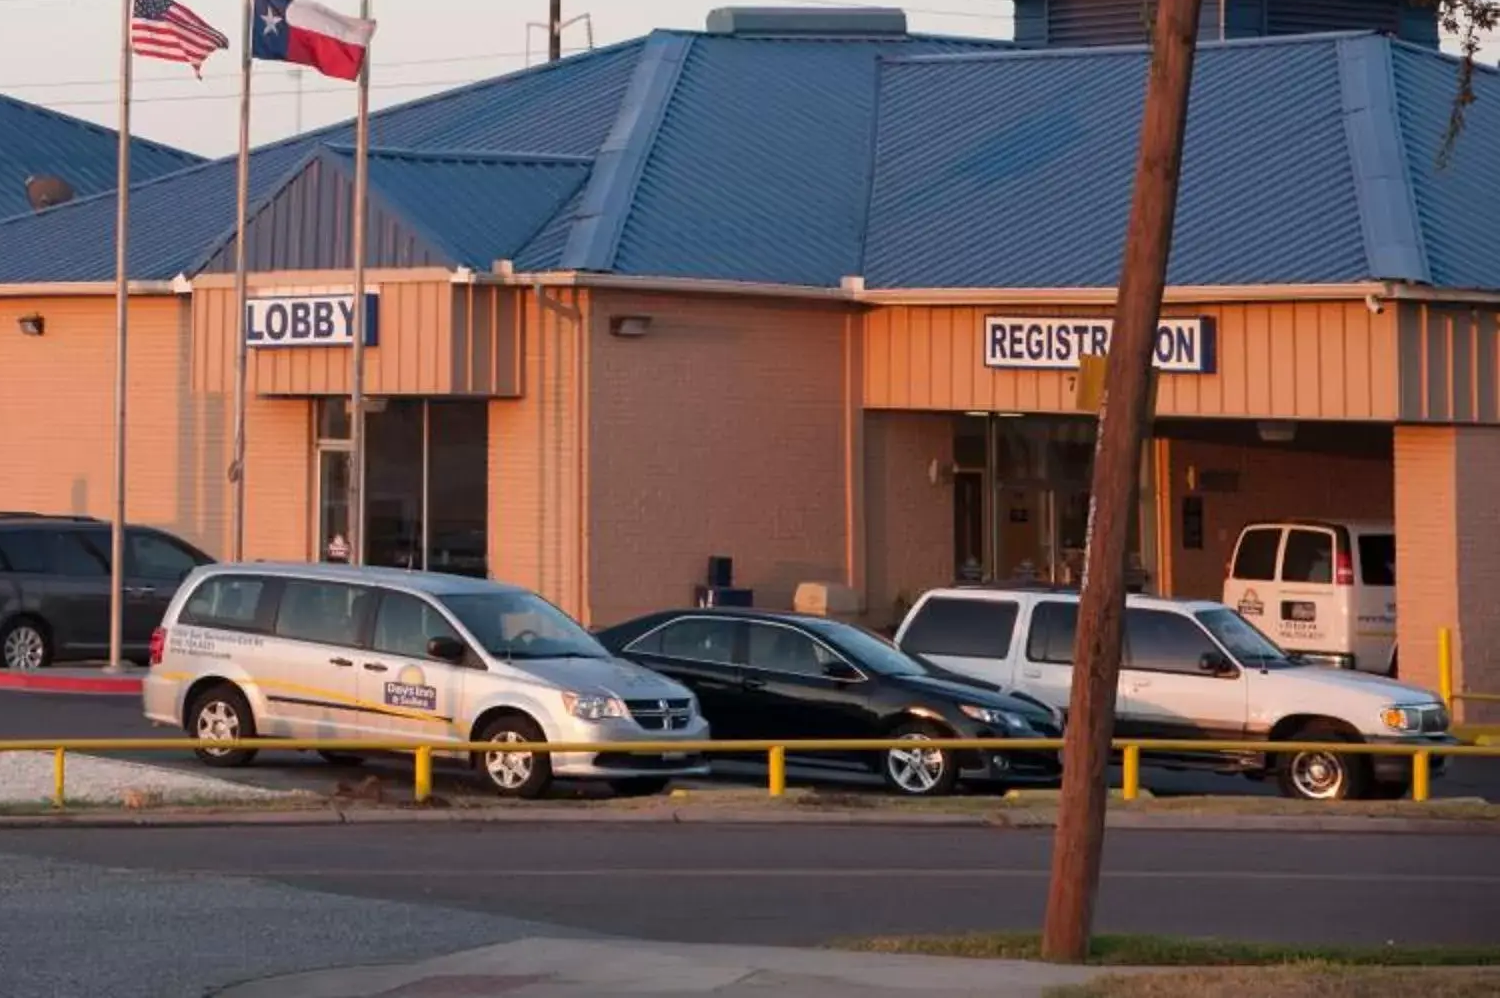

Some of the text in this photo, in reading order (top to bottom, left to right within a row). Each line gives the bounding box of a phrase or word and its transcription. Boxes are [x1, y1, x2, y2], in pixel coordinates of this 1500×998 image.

[246, 301, 355, 340] LOBBY
[991, 324, 1195, 363] REGISTRON
[388, 683, 415, 700] Days
